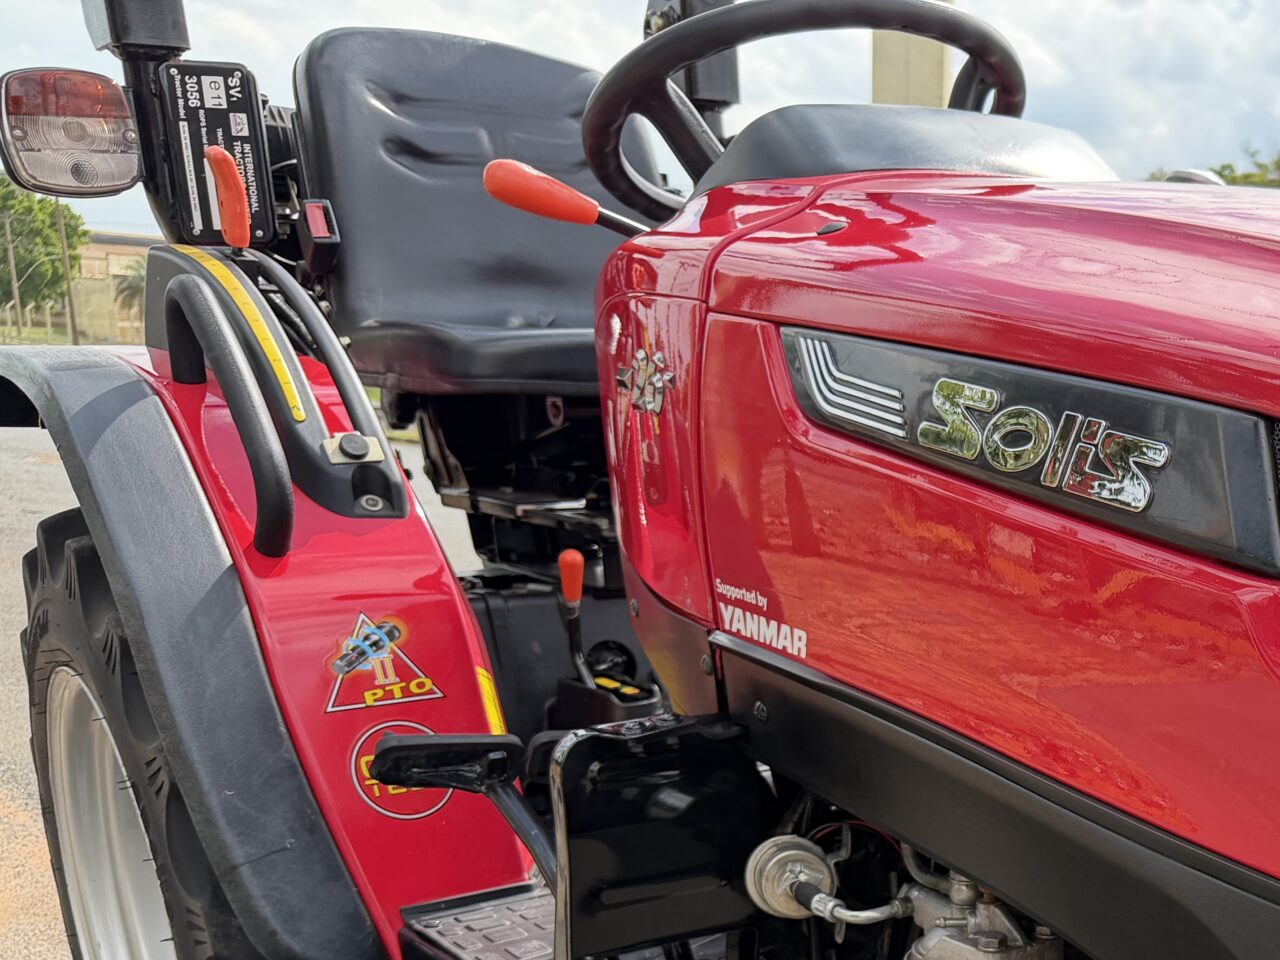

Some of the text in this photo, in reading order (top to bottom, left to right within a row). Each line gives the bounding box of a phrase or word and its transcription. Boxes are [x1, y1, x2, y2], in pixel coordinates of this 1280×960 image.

[174, 74, 187, 119] Tractor Model
[184, 75, 201, 108] 3056
[243, 143, 260, 214] INTERNATIONAL
[716, 578, 768, 611] Supported by
[719, 602, 808, 659] YANMAR
[363, 677, 433, 707] PTO
